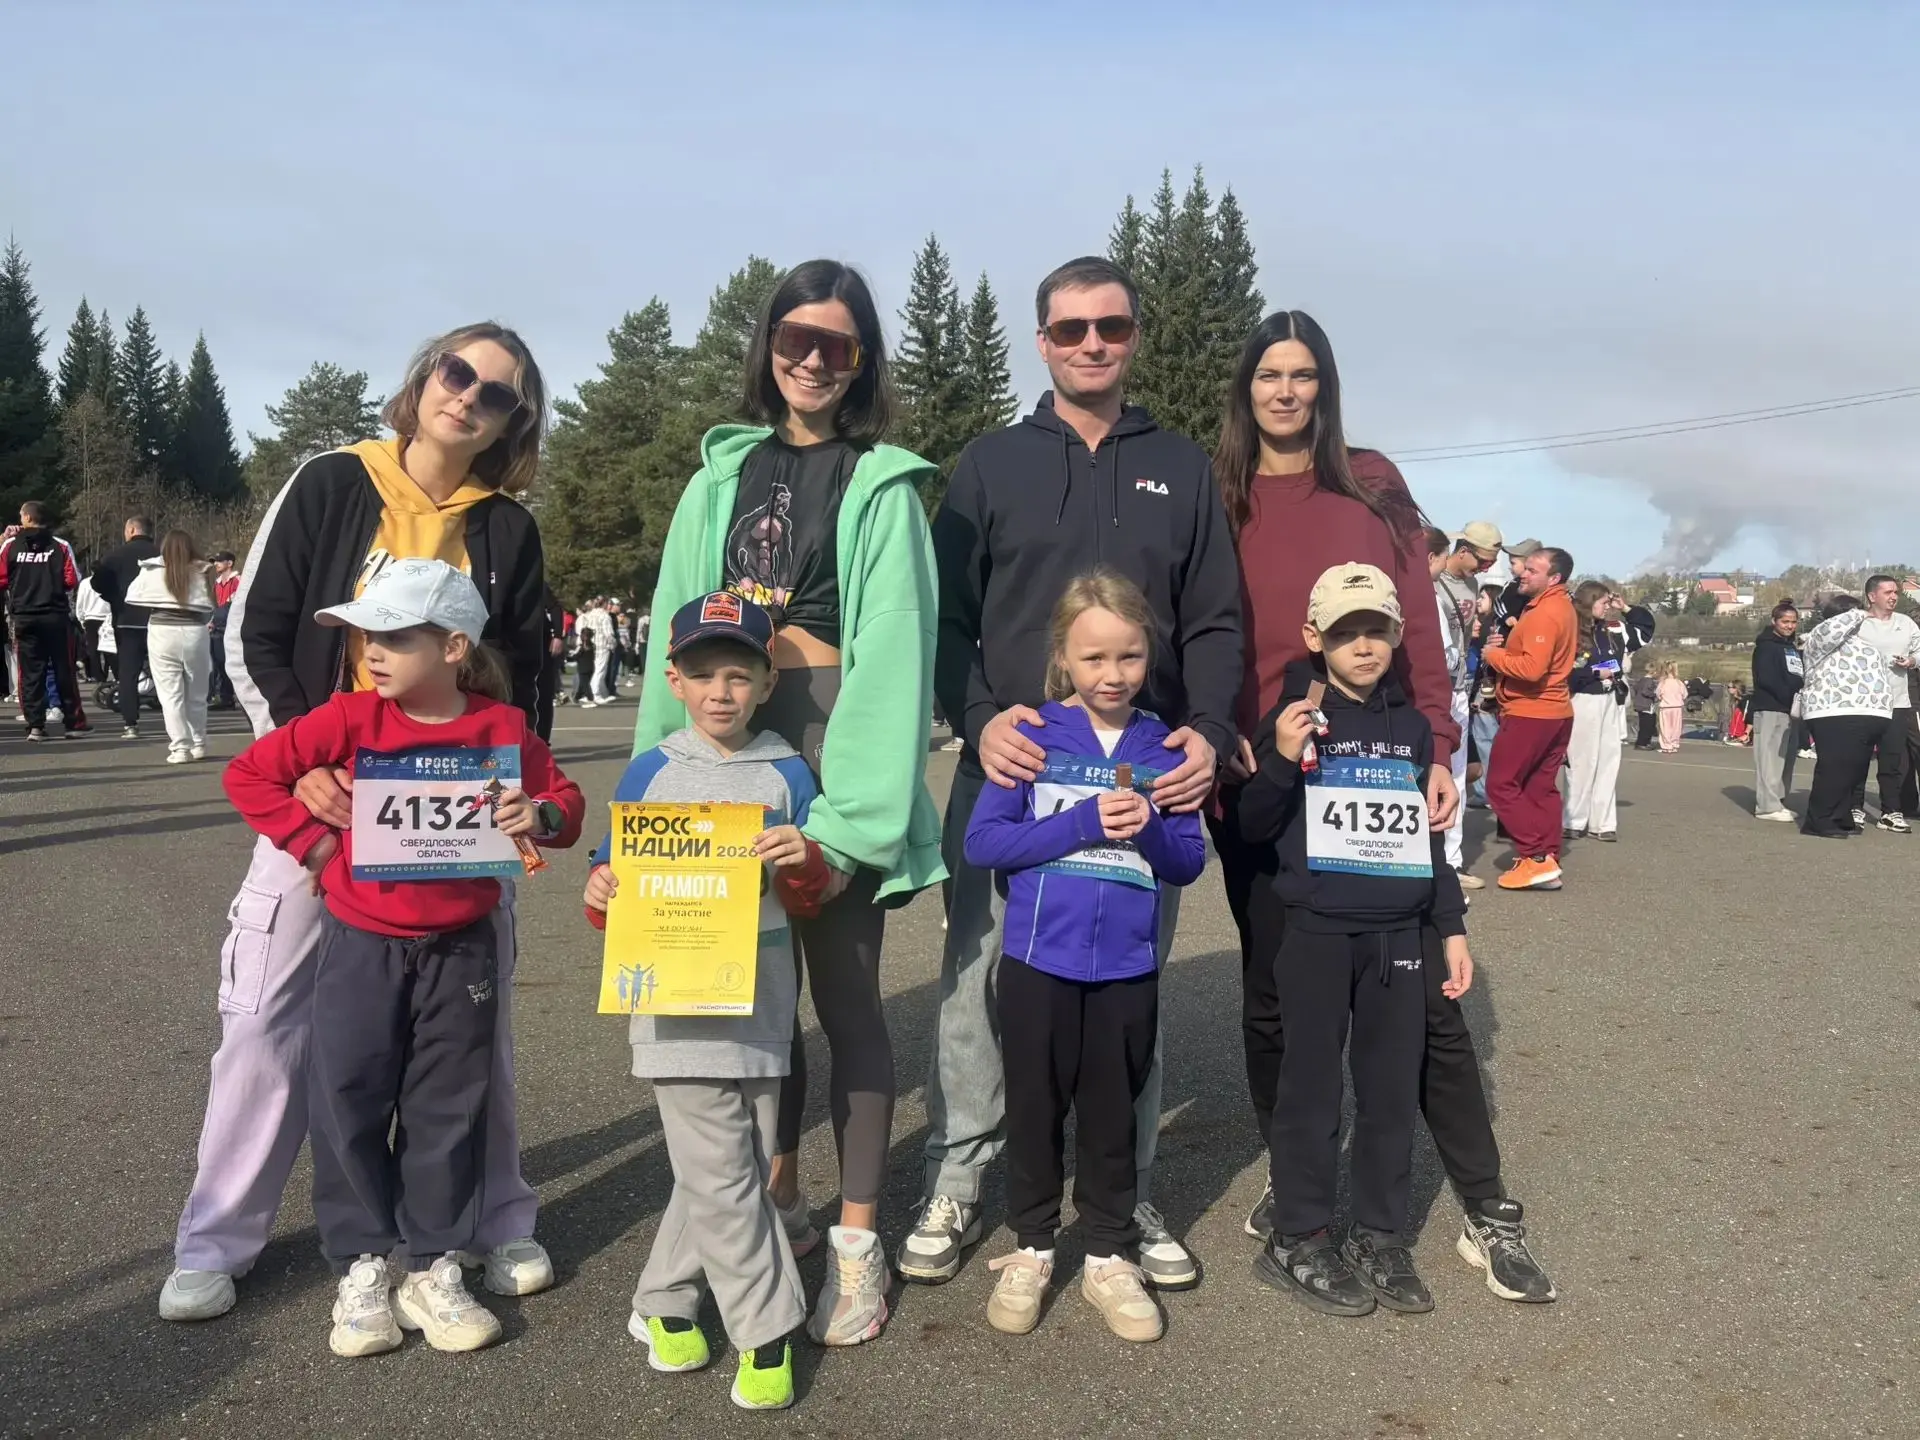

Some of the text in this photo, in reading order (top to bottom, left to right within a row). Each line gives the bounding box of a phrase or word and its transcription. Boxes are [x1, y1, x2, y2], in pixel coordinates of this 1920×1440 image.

[1135, 478, 1169, 495] FILA
[16, 549, 55, 563] HEAT
[1320, 741, 1362, 756] TOMMY
[415, 757, 459, 769] КРОСС
[1085, 766, 1117, 780] КРОС
[1355, 767, 1391, 779] КРОСС
[1322, 800, 1420, 835] 41323
[622, 815, 691, 836] КРОСС
[400, 838, 476, 848] СВЕРДЛОВСКАЯ
[621, 837, 759, 861] НАЦИИ 2026
[1345, 838, 1404, 849] СВЕРДЛОВСКАЯ
[416, 849, 461, 858] ОБЛАСТЬ
[1082, 849, 1124, 861] ОБЛАСТЬ
[1358, 849, 1394, 859] ОБЛАСТЬ
[639, 873, 728, 899] ГРАМОТА
[652, 907, 712, 919] За участие
